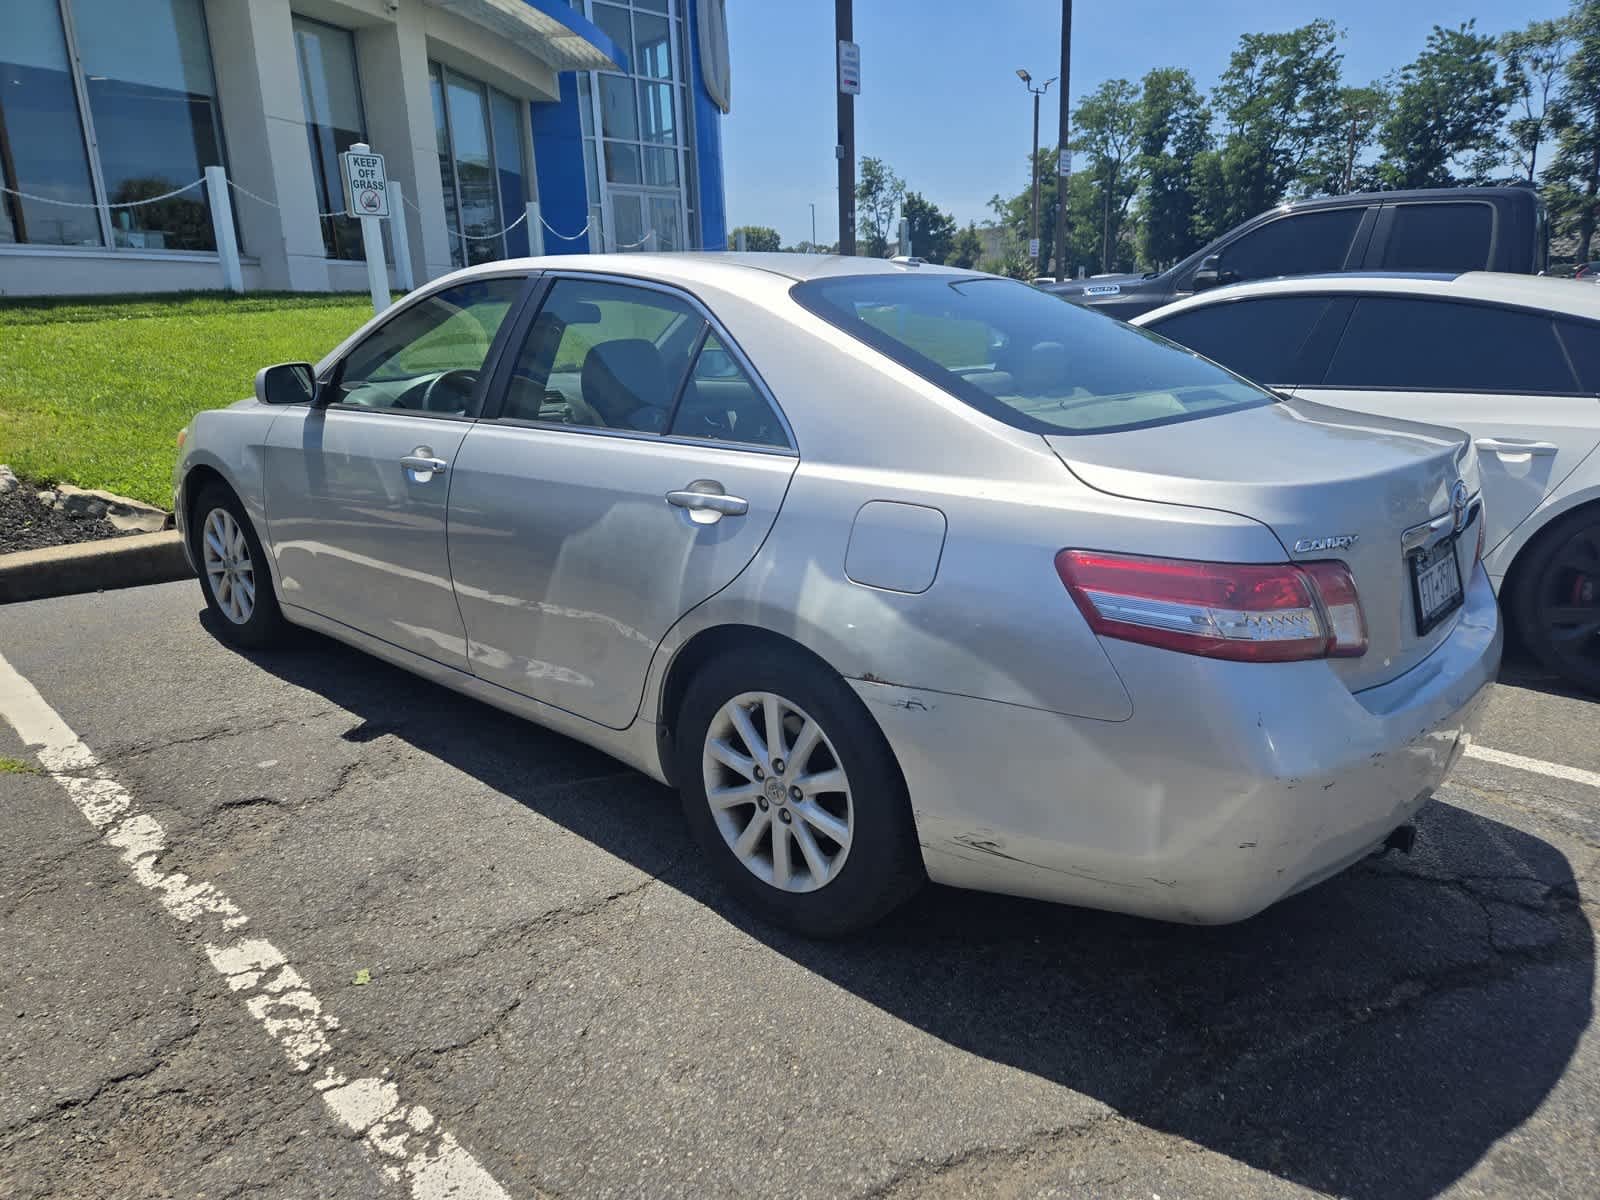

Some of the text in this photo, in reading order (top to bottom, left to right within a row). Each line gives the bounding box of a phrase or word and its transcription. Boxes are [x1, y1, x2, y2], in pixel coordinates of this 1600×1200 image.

[353, 157, 377, 168] KEEP
[358, 168, 376, 179] OFF
[353, 180, 384, 191] GRASS
[1294, 535, 1359, 552] CAMRY
